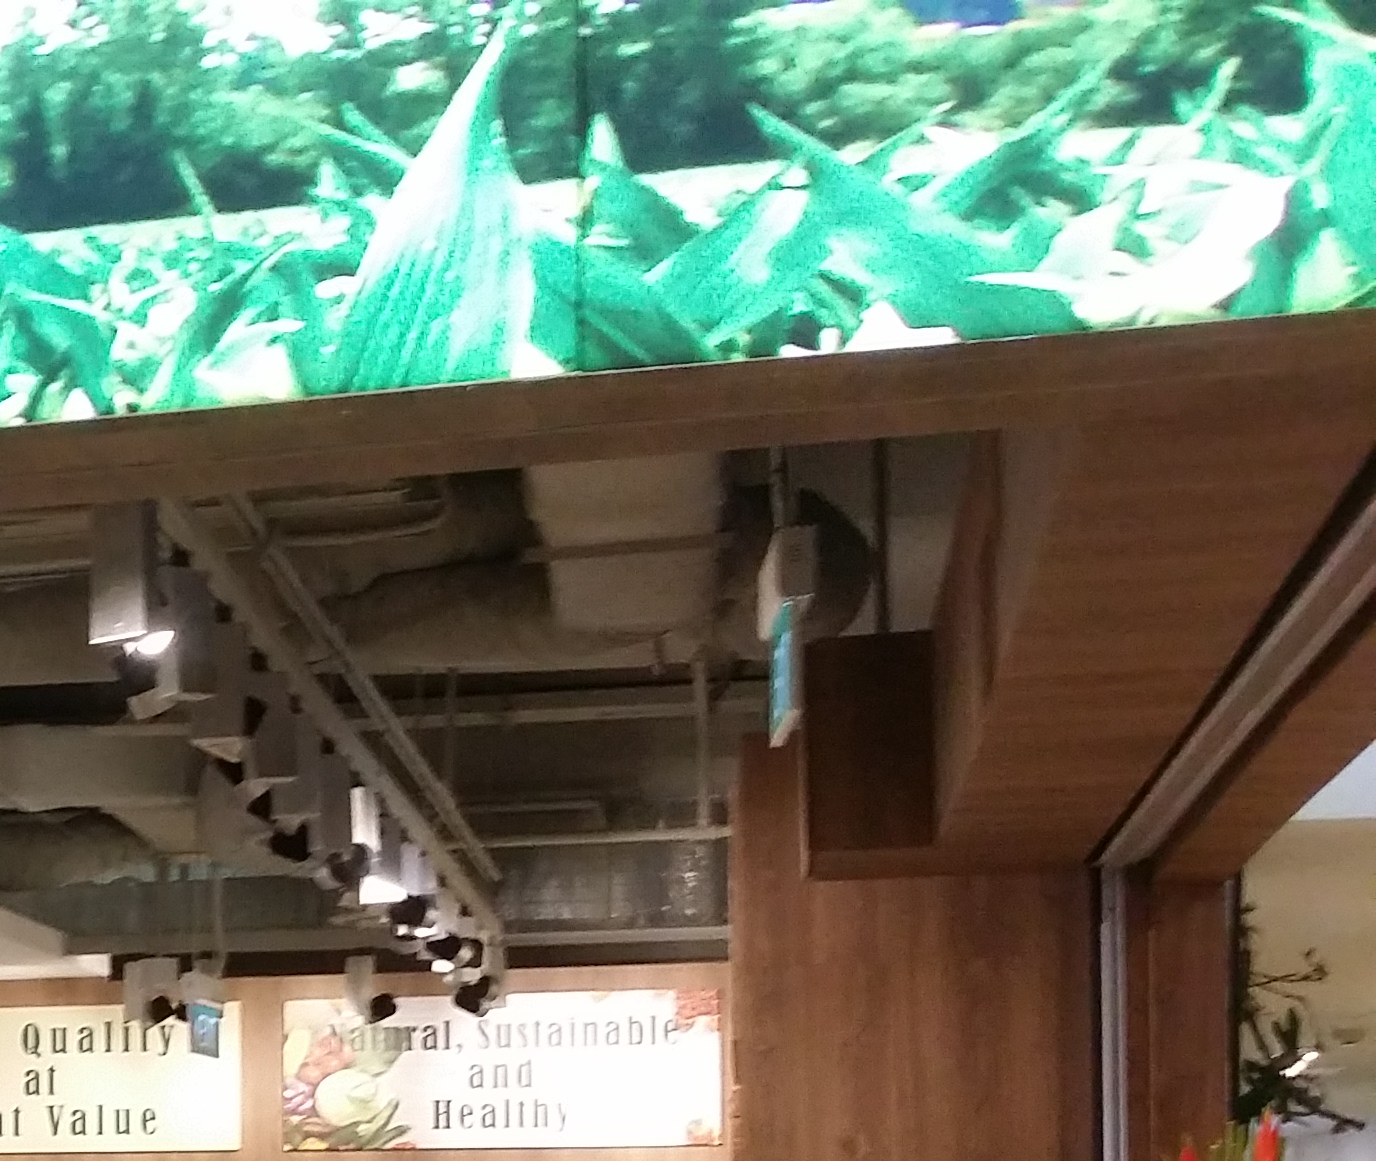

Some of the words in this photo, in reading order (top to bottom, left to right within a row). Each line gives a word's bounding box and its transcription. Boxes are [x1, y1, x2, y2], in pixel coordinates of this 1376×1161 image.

[477, 1014, 680, 1049] Sustainable
[22, 1064, 58, 1097] at
[468, 1058, 534, 1089] and
[46, 1103, 158, 1137] Value
[431, 1099, 570, 1132] Healthy
